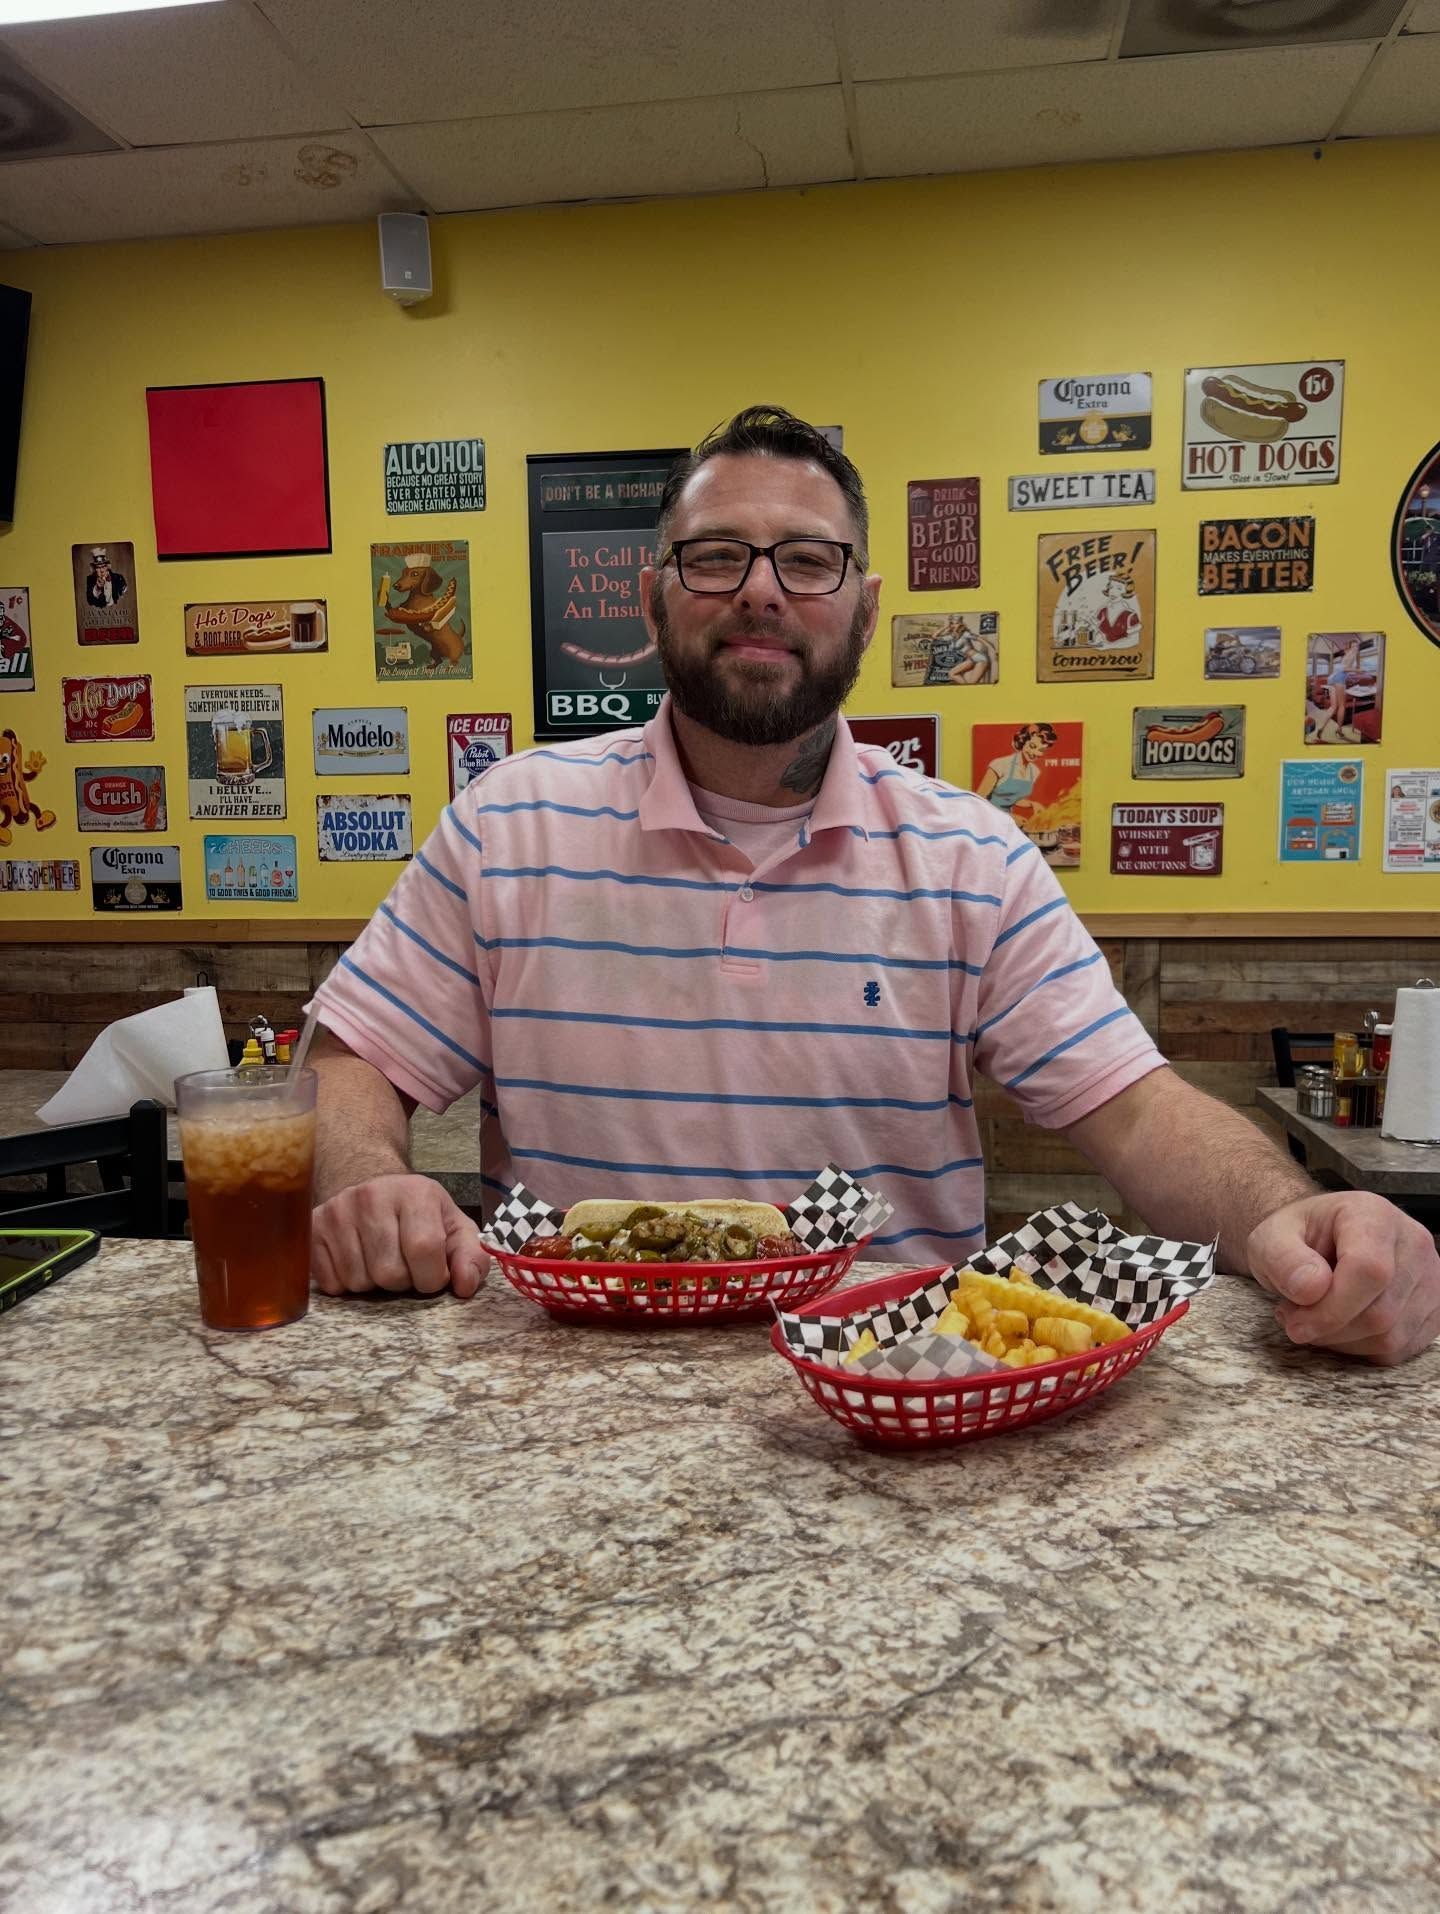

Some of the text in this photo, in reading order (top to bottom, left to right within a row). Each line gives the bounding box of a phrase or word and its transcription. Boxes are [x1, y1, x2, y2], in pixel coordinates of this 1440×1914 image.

[1053, 380, 1132, 404] Corona
[1077, 398, 1109, 409] Extra
[386, 441, 483, 475] ALCOHOL
[1189, 440, 1335, 474] HOT DOGS
[386, 472, 483, 488] BECAUSE NO GREAT STORY
[387, 484, 484, 500] EVER STARTED WITH
[545, 482, 664, 502] DON'T BE A RICHAR
[933, 488, 967, 502] DRINK
[1017, 474, 1147, 506] SWEET TEA
[387, 497, 484, 512] SOMEONE EATING A SALAD
[933, 502, 978, 518] GOOD
[911, 516, 977, 548] BEER
[1203, 521, 1311, 551] BACON
[565, 546, 655, 568] To Call It
[931, 542, 977, 563] GOOD
[1046, 535, 1112, 582] FREE
[1203, 549, 1309, 563] MAKES EVERYTHING
[913, 557, 979, 585] FRIENDS
[1062, 542, 1143, 597] BEER!
[1202, 561, 1309, 591] BETTER
[568, 574, 585, 593] A
[590, 573, 632, 599] Dog
[195, 607, 276, 630] Hot Dogs
[563, 600, 592, 619] An
[203, 631, 222, 647] ROOT
[224, 630, 242, 647] BEER
[1053, 650, 1143, 666] tomorrow
[68, 679, 146, 723] Hot Dogs
[201, 689, 238, 699] EVERYONE
[230, 700, 239, 713] TO
[240, 700, 270, 712] BELIEVE
[271, 700, 280, 712] IN
[551, 693, 664, 721] BBQ BLV
[449, 717, 510, 733] ICE COLD
[328, 723, 394, 748] Modelo
[469, 746, 489, 758] Pabst
[88, 782, 142, 806] Crush
[209, 786, 213, 795] I
[195, 804, 282, 816] ANOTHER BEER
[1118, 808, 1218, 824] TODAY'S SOUP
[322, 811, 406, 831] ABSOLUT
[331, 831, 399, 851] VODKA
[1117, 830, 1171, 840] WHISKEY
[102, 848, 165, 870] Corona
[1138, 845, 1169, 855] WITH
[121, 865, 146, 875] Extra
[1116, 861, 1187, 871] ICE CROUTONS
[208, 888, 216, 897] TO
[217, 888, 233, 897] GOOD
[255, 888, 270, 897] GOOD
